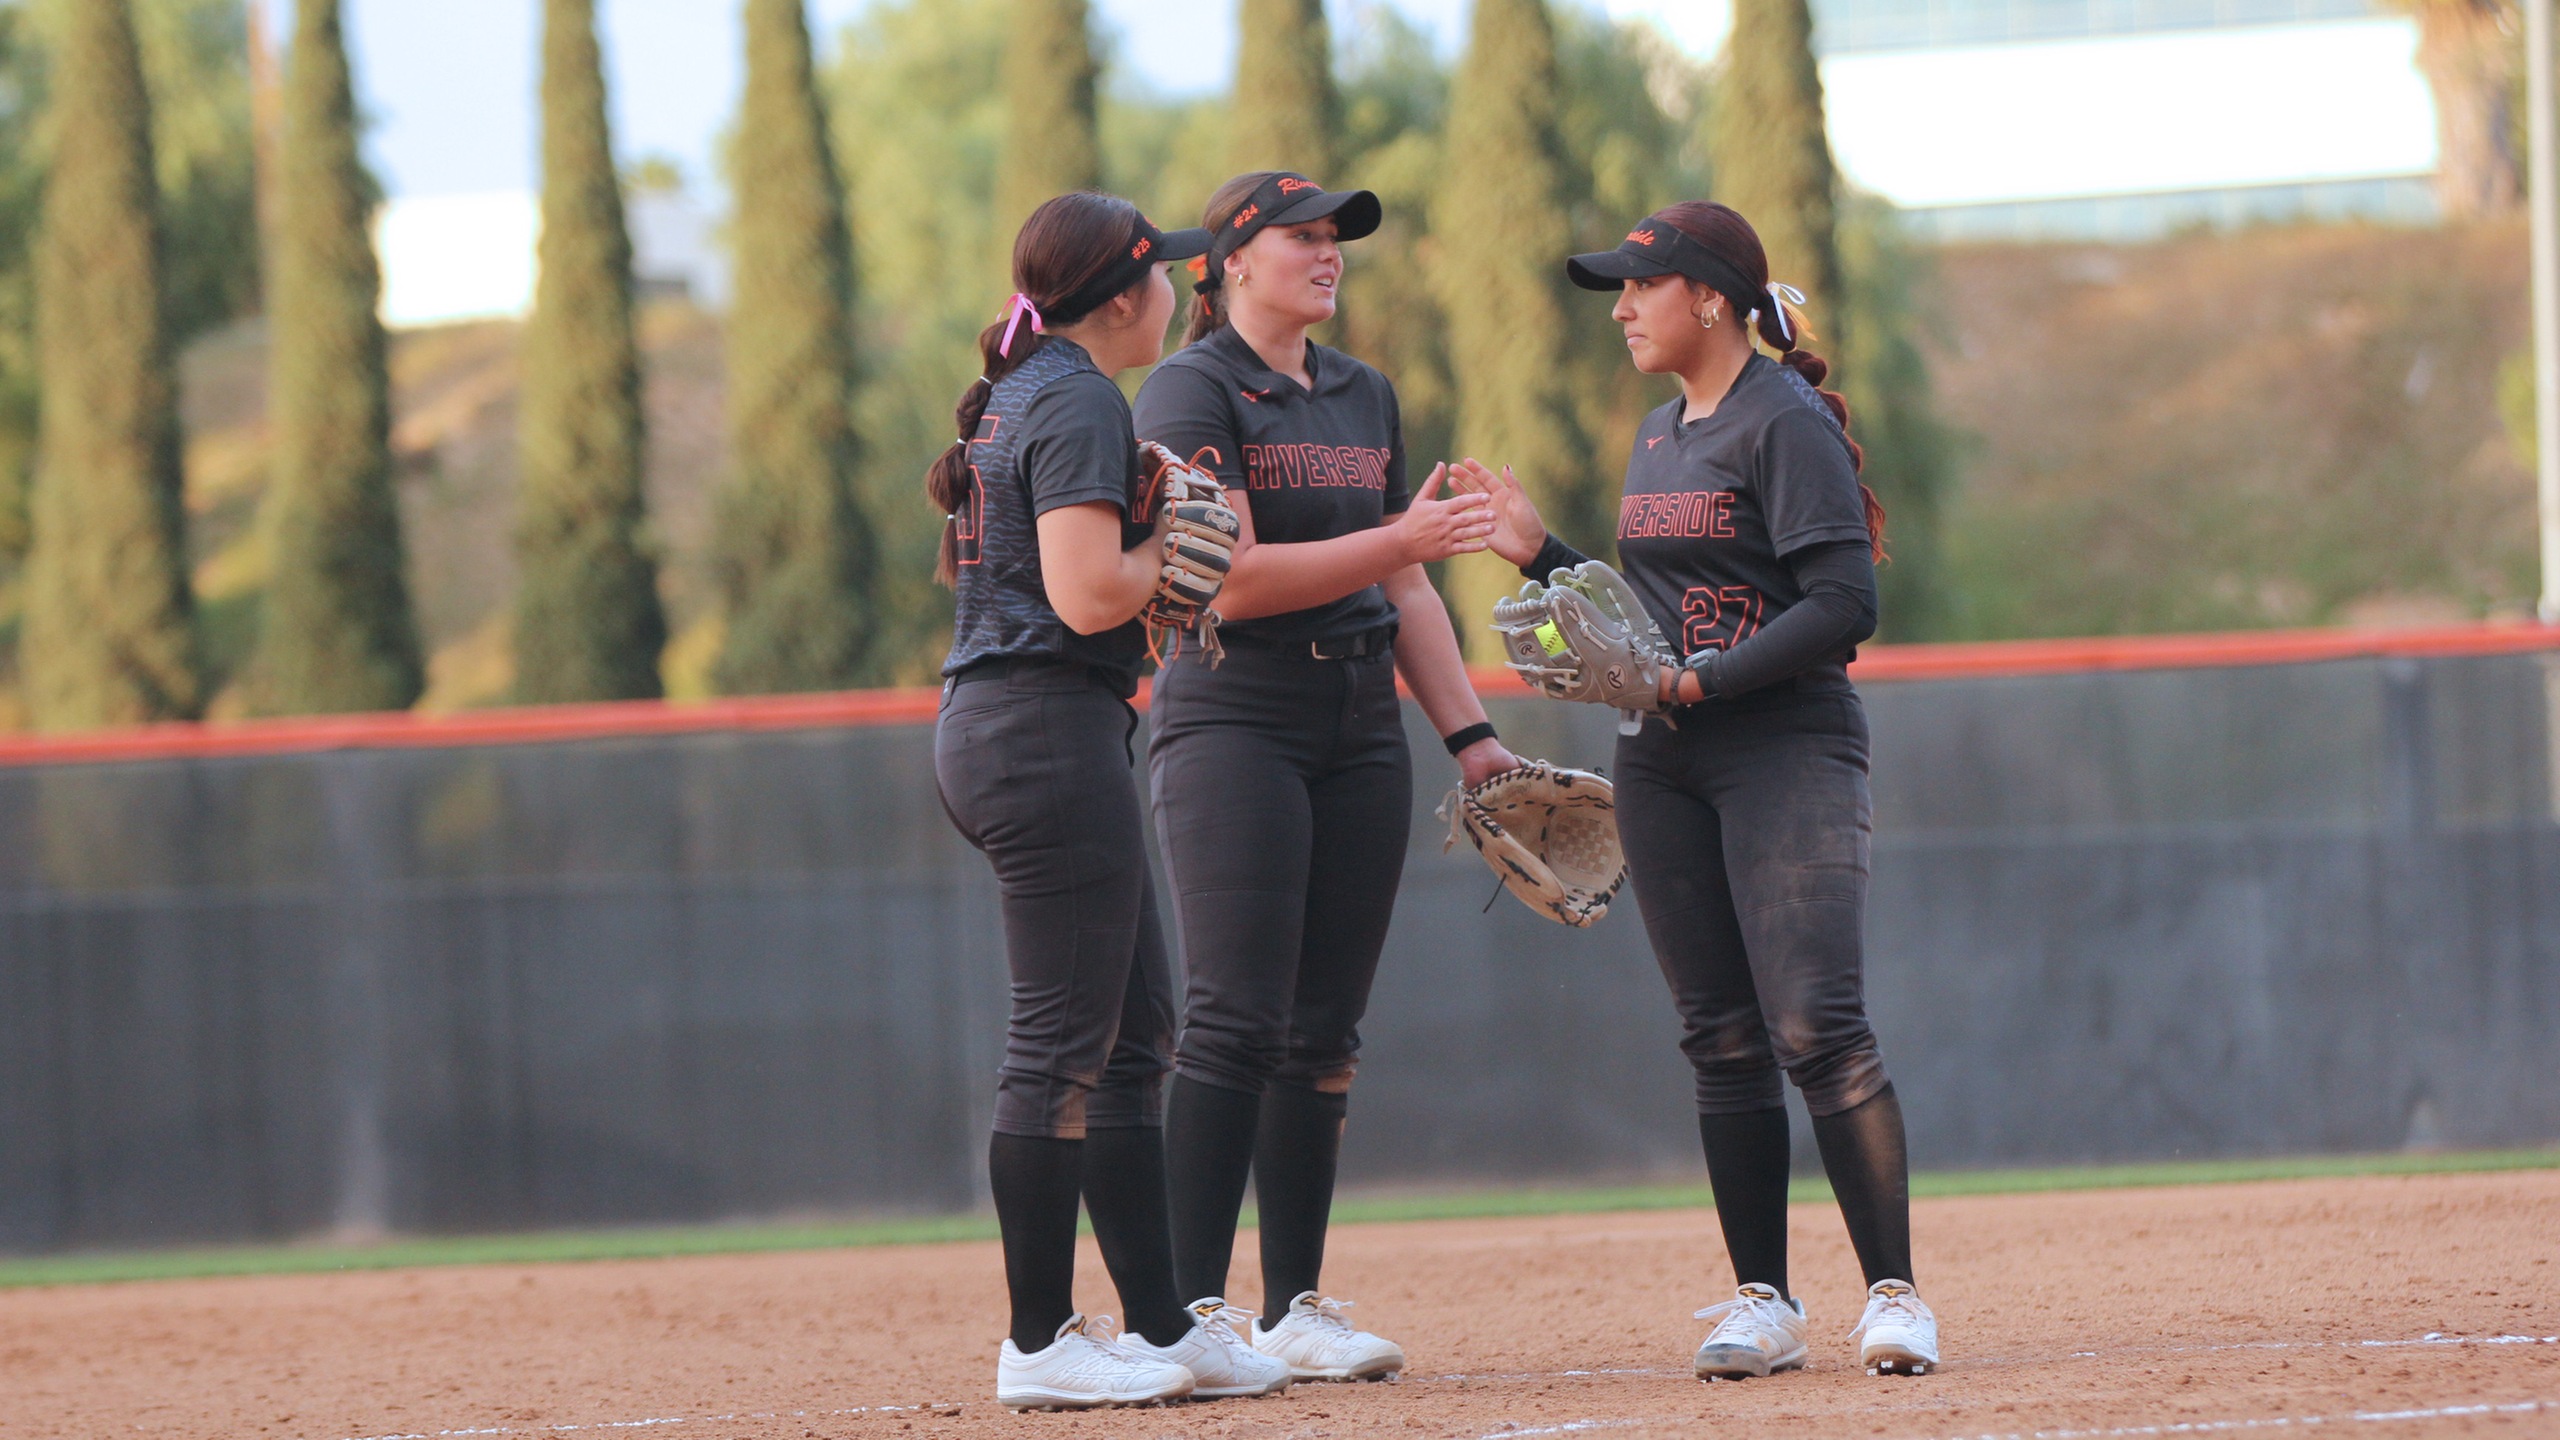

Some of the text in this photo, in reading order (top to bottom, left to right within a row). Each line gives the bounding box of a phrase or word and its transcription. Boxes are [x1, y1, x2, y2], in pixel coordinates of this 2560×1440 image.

[1233, 203, 1259, 228] #24
[1131, 237, 1151, 260] #25
[1617, 491, 1735, 540] VERSIDE
[1682, 585, 1764, 657] 27
